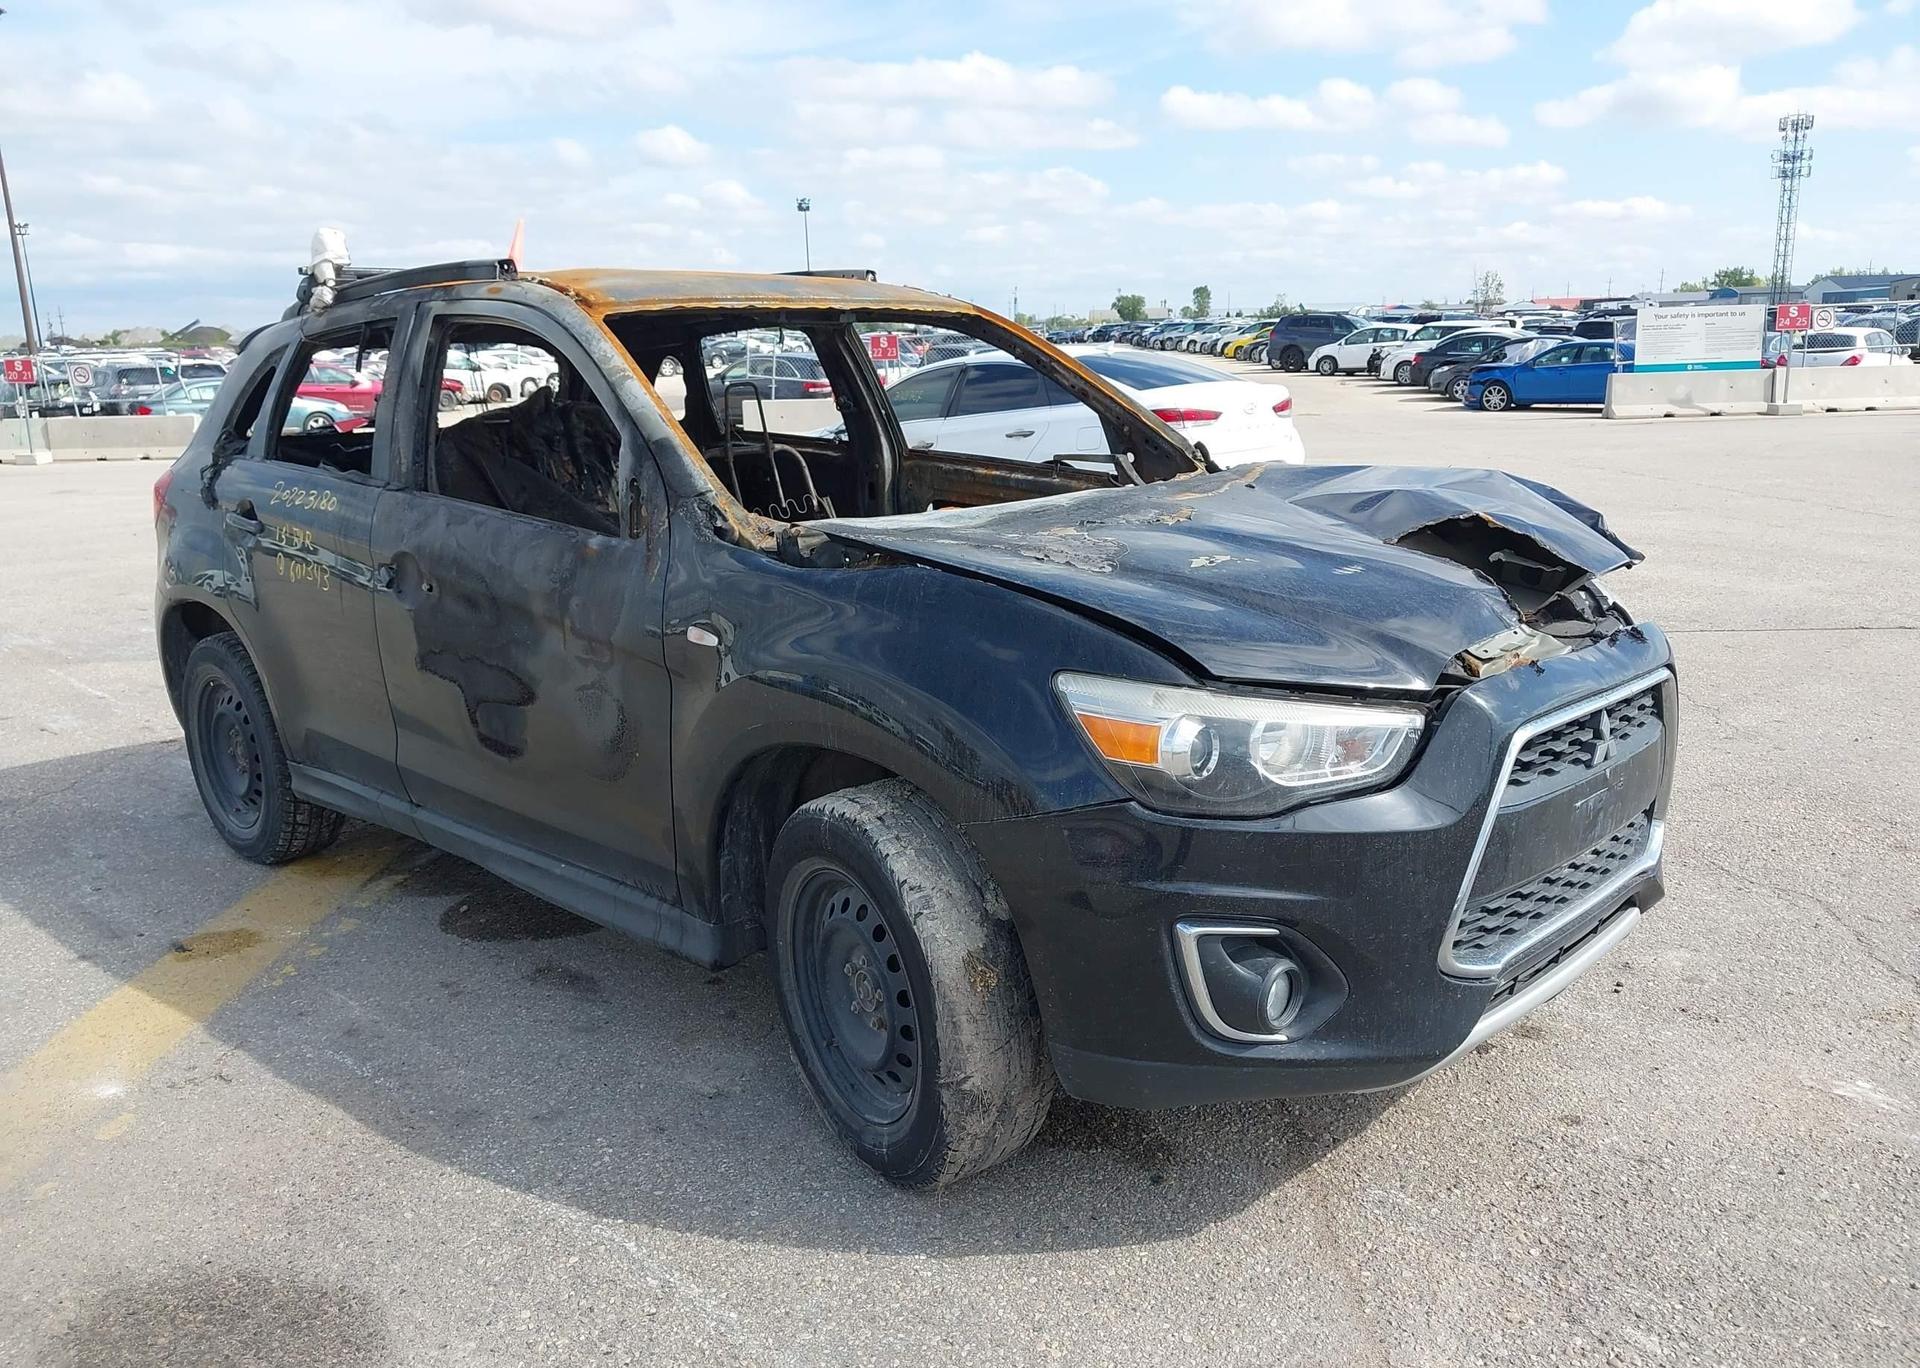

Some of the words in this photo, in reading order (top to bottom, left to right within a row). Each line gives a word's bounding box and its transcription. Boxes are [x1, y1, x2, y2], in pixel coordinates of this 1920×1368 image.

[1670, 311, 1690, 319] safety
[1697, 311, 1729, 319] important
[1788, 306, 1799, 317] S
[1778, 318, 1790, 326] 24
[1796, 317, 1808, 326] 25
[880, 336, 889, 348] S
[872, 348, 883, 357] 22
[887, 347, 897, 357] 23
[14, 360, 23, 371] S
[8, 371, 18, 380] 20
[22, 371, 32, 380] 21
